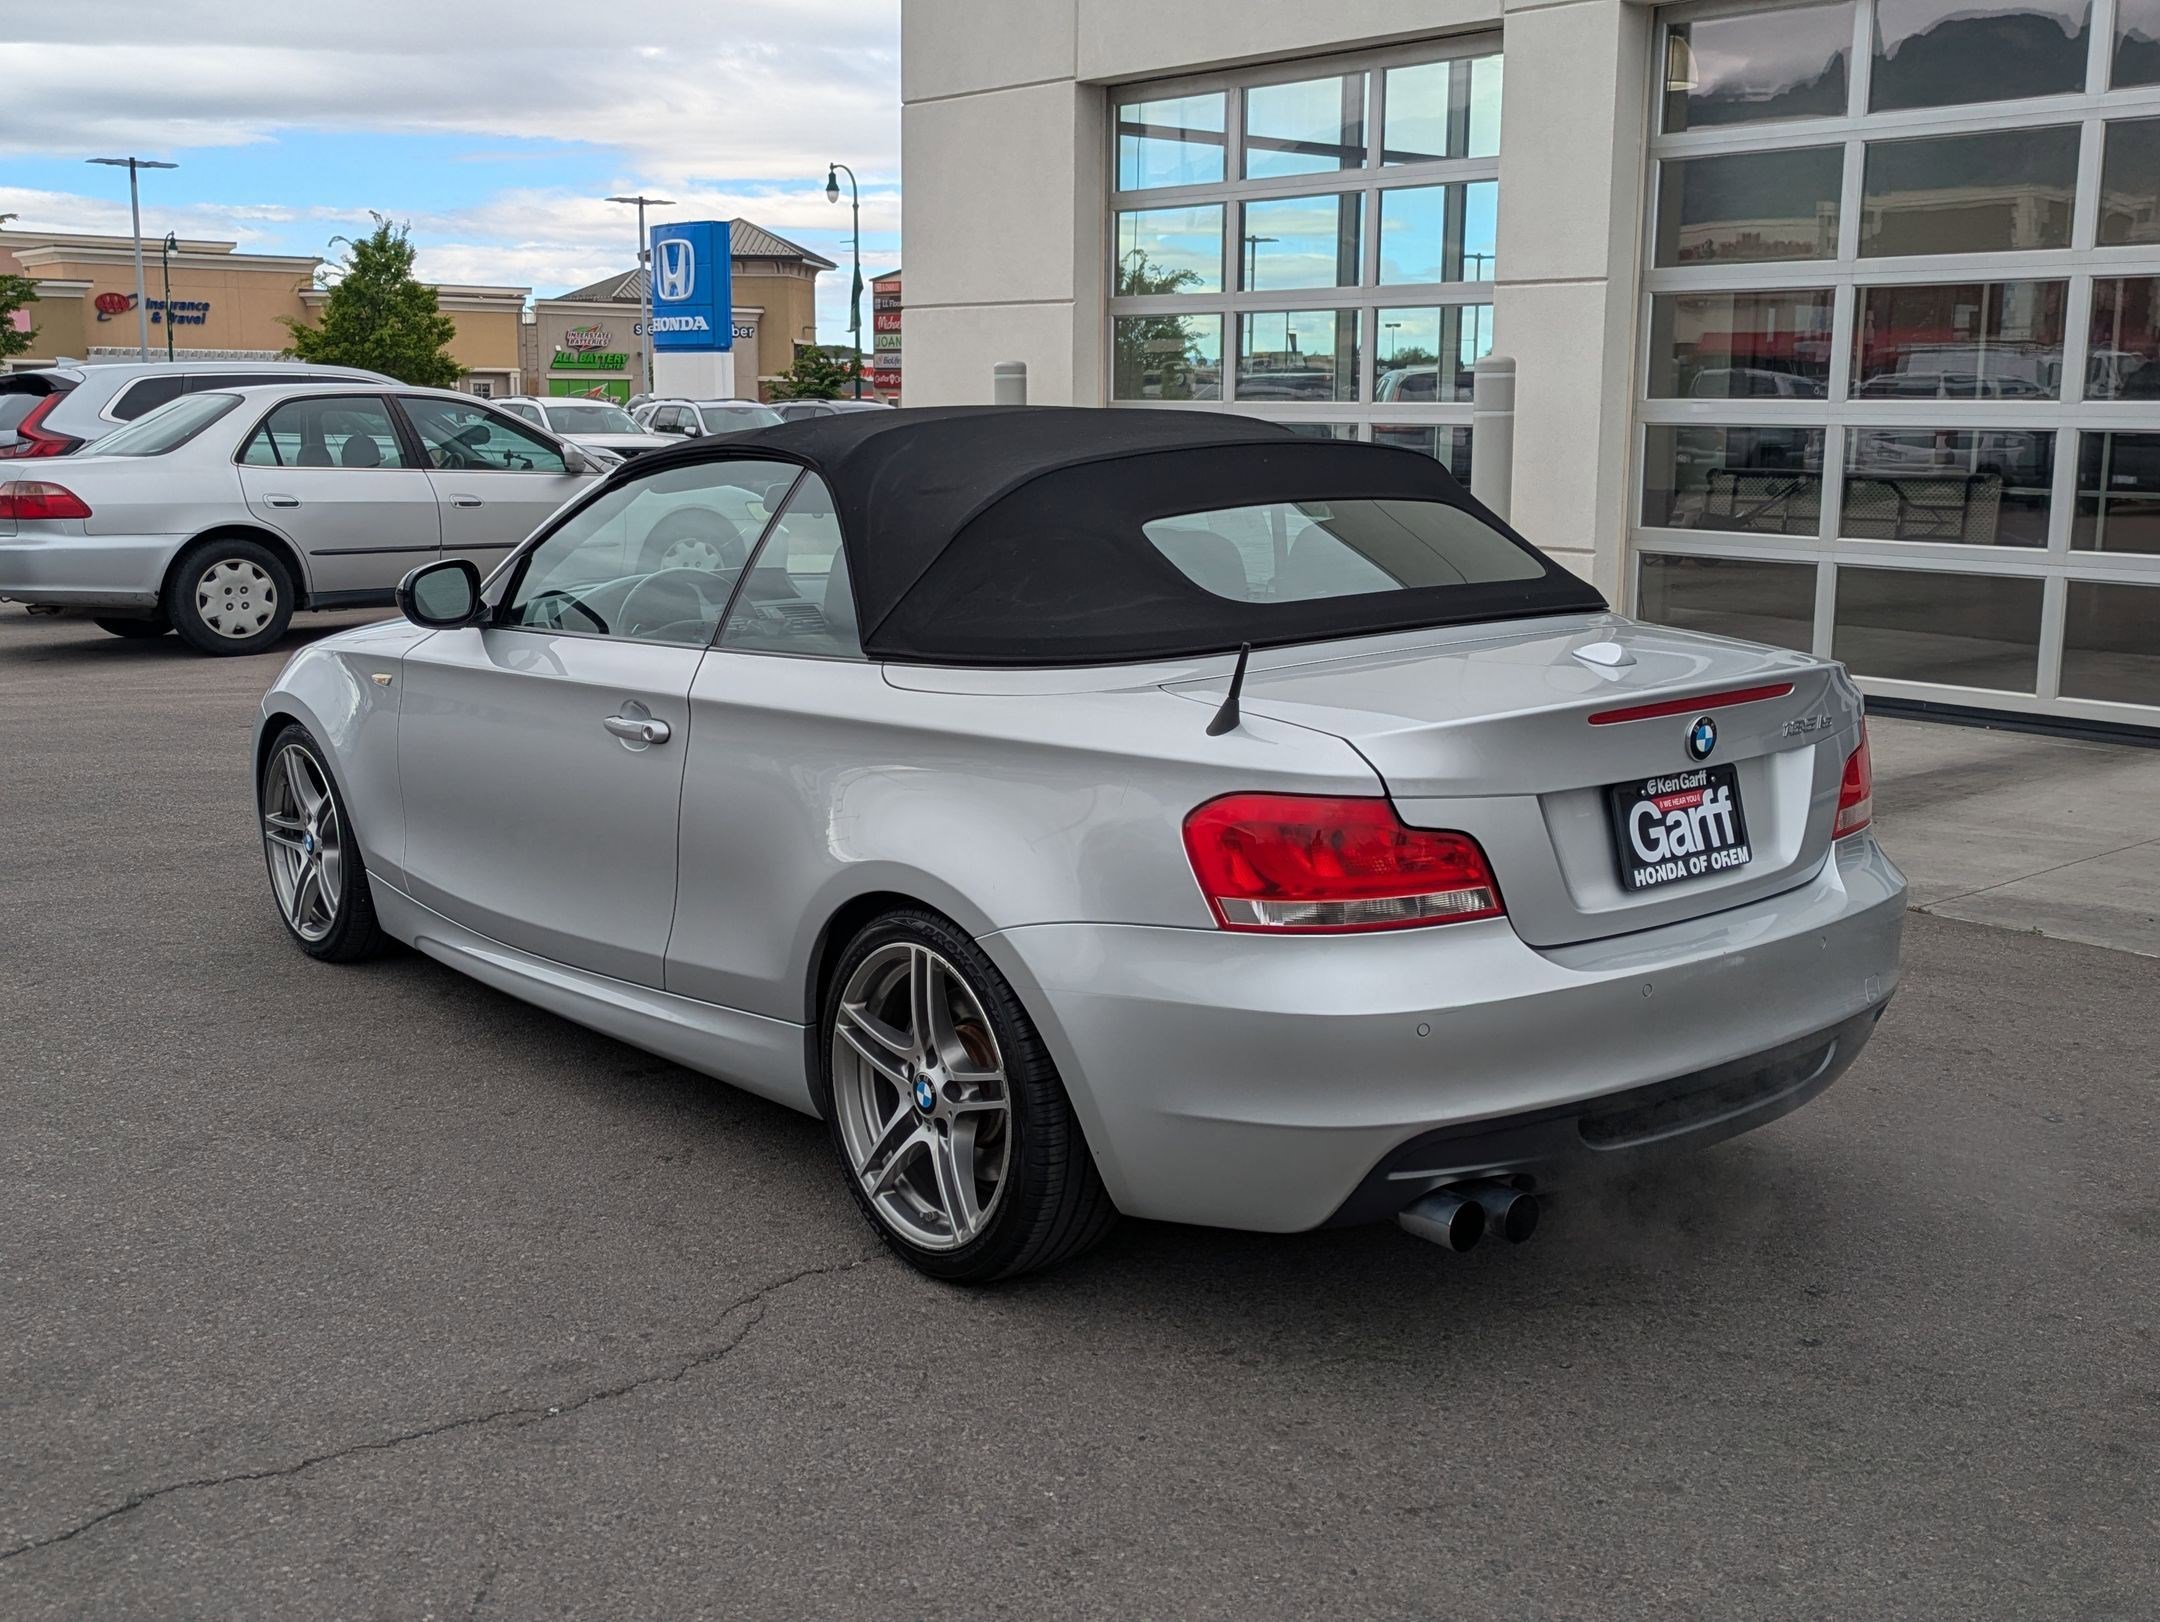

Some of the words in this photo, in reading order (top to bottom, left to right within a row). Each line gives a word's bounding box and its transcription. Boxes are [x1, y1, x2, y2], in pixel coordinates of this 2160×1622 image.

[99, 295, 128, 312] AAA
[653, 316, 709, 332] HONDA
[878, 315, 901, 330] Michae
[566, 330, 611, 340] INTERSTATE
[731, 323, 754, 338] ber
[875, 336, 901, 348] JOAN
[555, 352, 575, 362] ALL
[579, 352, 628, 363] BATTERY
[1657, 777, 1679, 794] Ken
[1680, 769, 1707, 789] Garff
[1663, 799, 1672, 808] WE
[1672, 796, 1686, 806] HEAR
[1686, 794, 1697, 803] YOU
[1629, 785, 1735, 863] Garff
[1634, 861, 1687, 887] HONDA
[1689, 855, 1708, 874] OF
[1711, 846, 1750, 870] OREM
